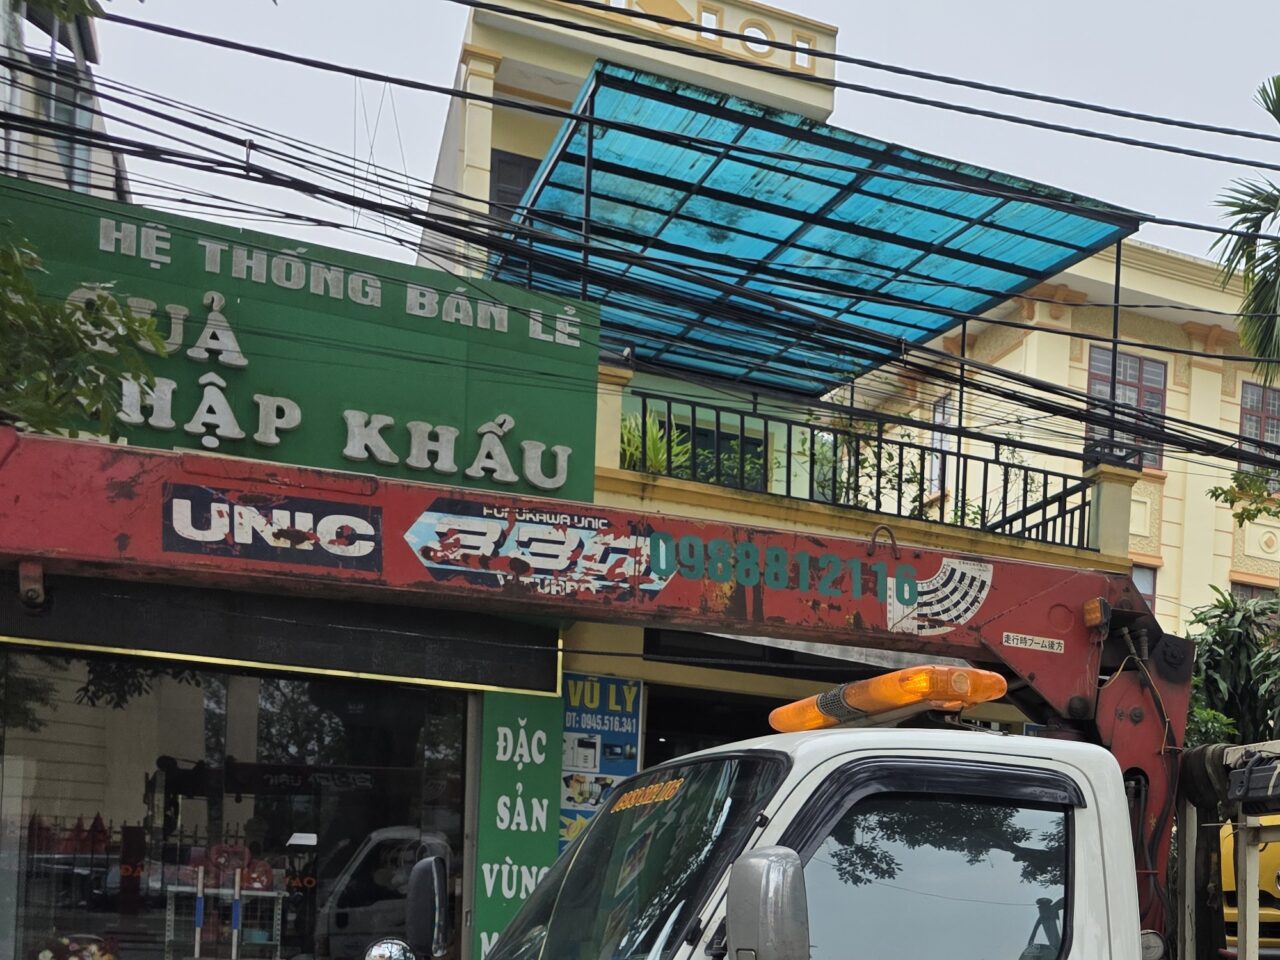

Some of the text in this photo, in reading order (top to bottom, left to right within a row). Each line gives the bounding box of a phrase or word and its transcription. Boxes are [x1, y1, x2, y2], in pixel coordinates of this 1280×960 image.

[100, 217, 581, 348] HỆ THỐNG BÁN LẺ
[342, 411, 572, 490] KHẨU
[171, 498, 376, 557] UNIC
[650, 531, 919, 606] 0988812116
[1003, 634, 1064, 651] 走行時ブーム後方
[496, 718, 547, 771] ĐẶC
[581, 713, 637, 733] 0945.516.341
[496, 782, 549, 832] SẢN
